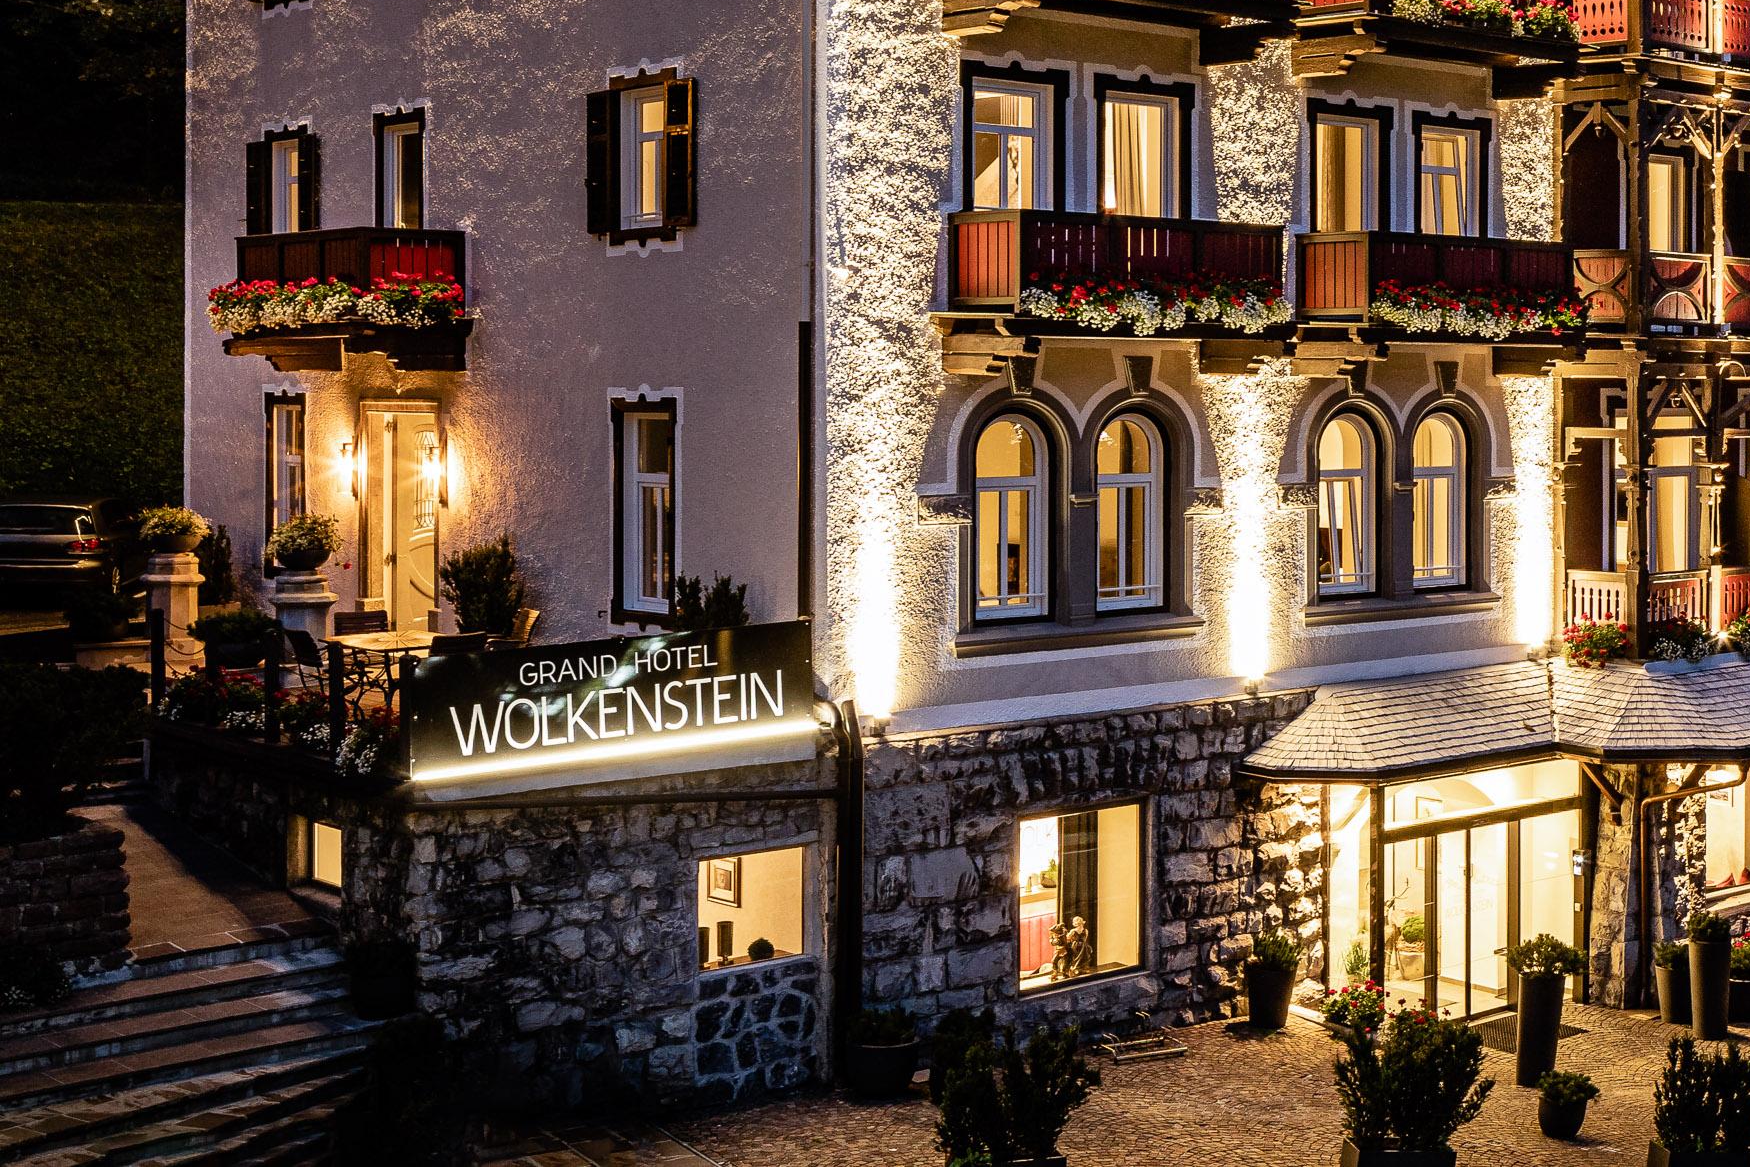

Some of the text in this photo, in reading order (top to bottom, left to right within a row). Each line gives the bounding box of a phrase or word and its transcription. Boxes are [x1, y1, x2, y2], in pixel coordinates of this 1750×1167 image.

[519, 645, 719, 686] GRAND HOTEL
[449, 671, 784, 756] WOLKENSTEIN
